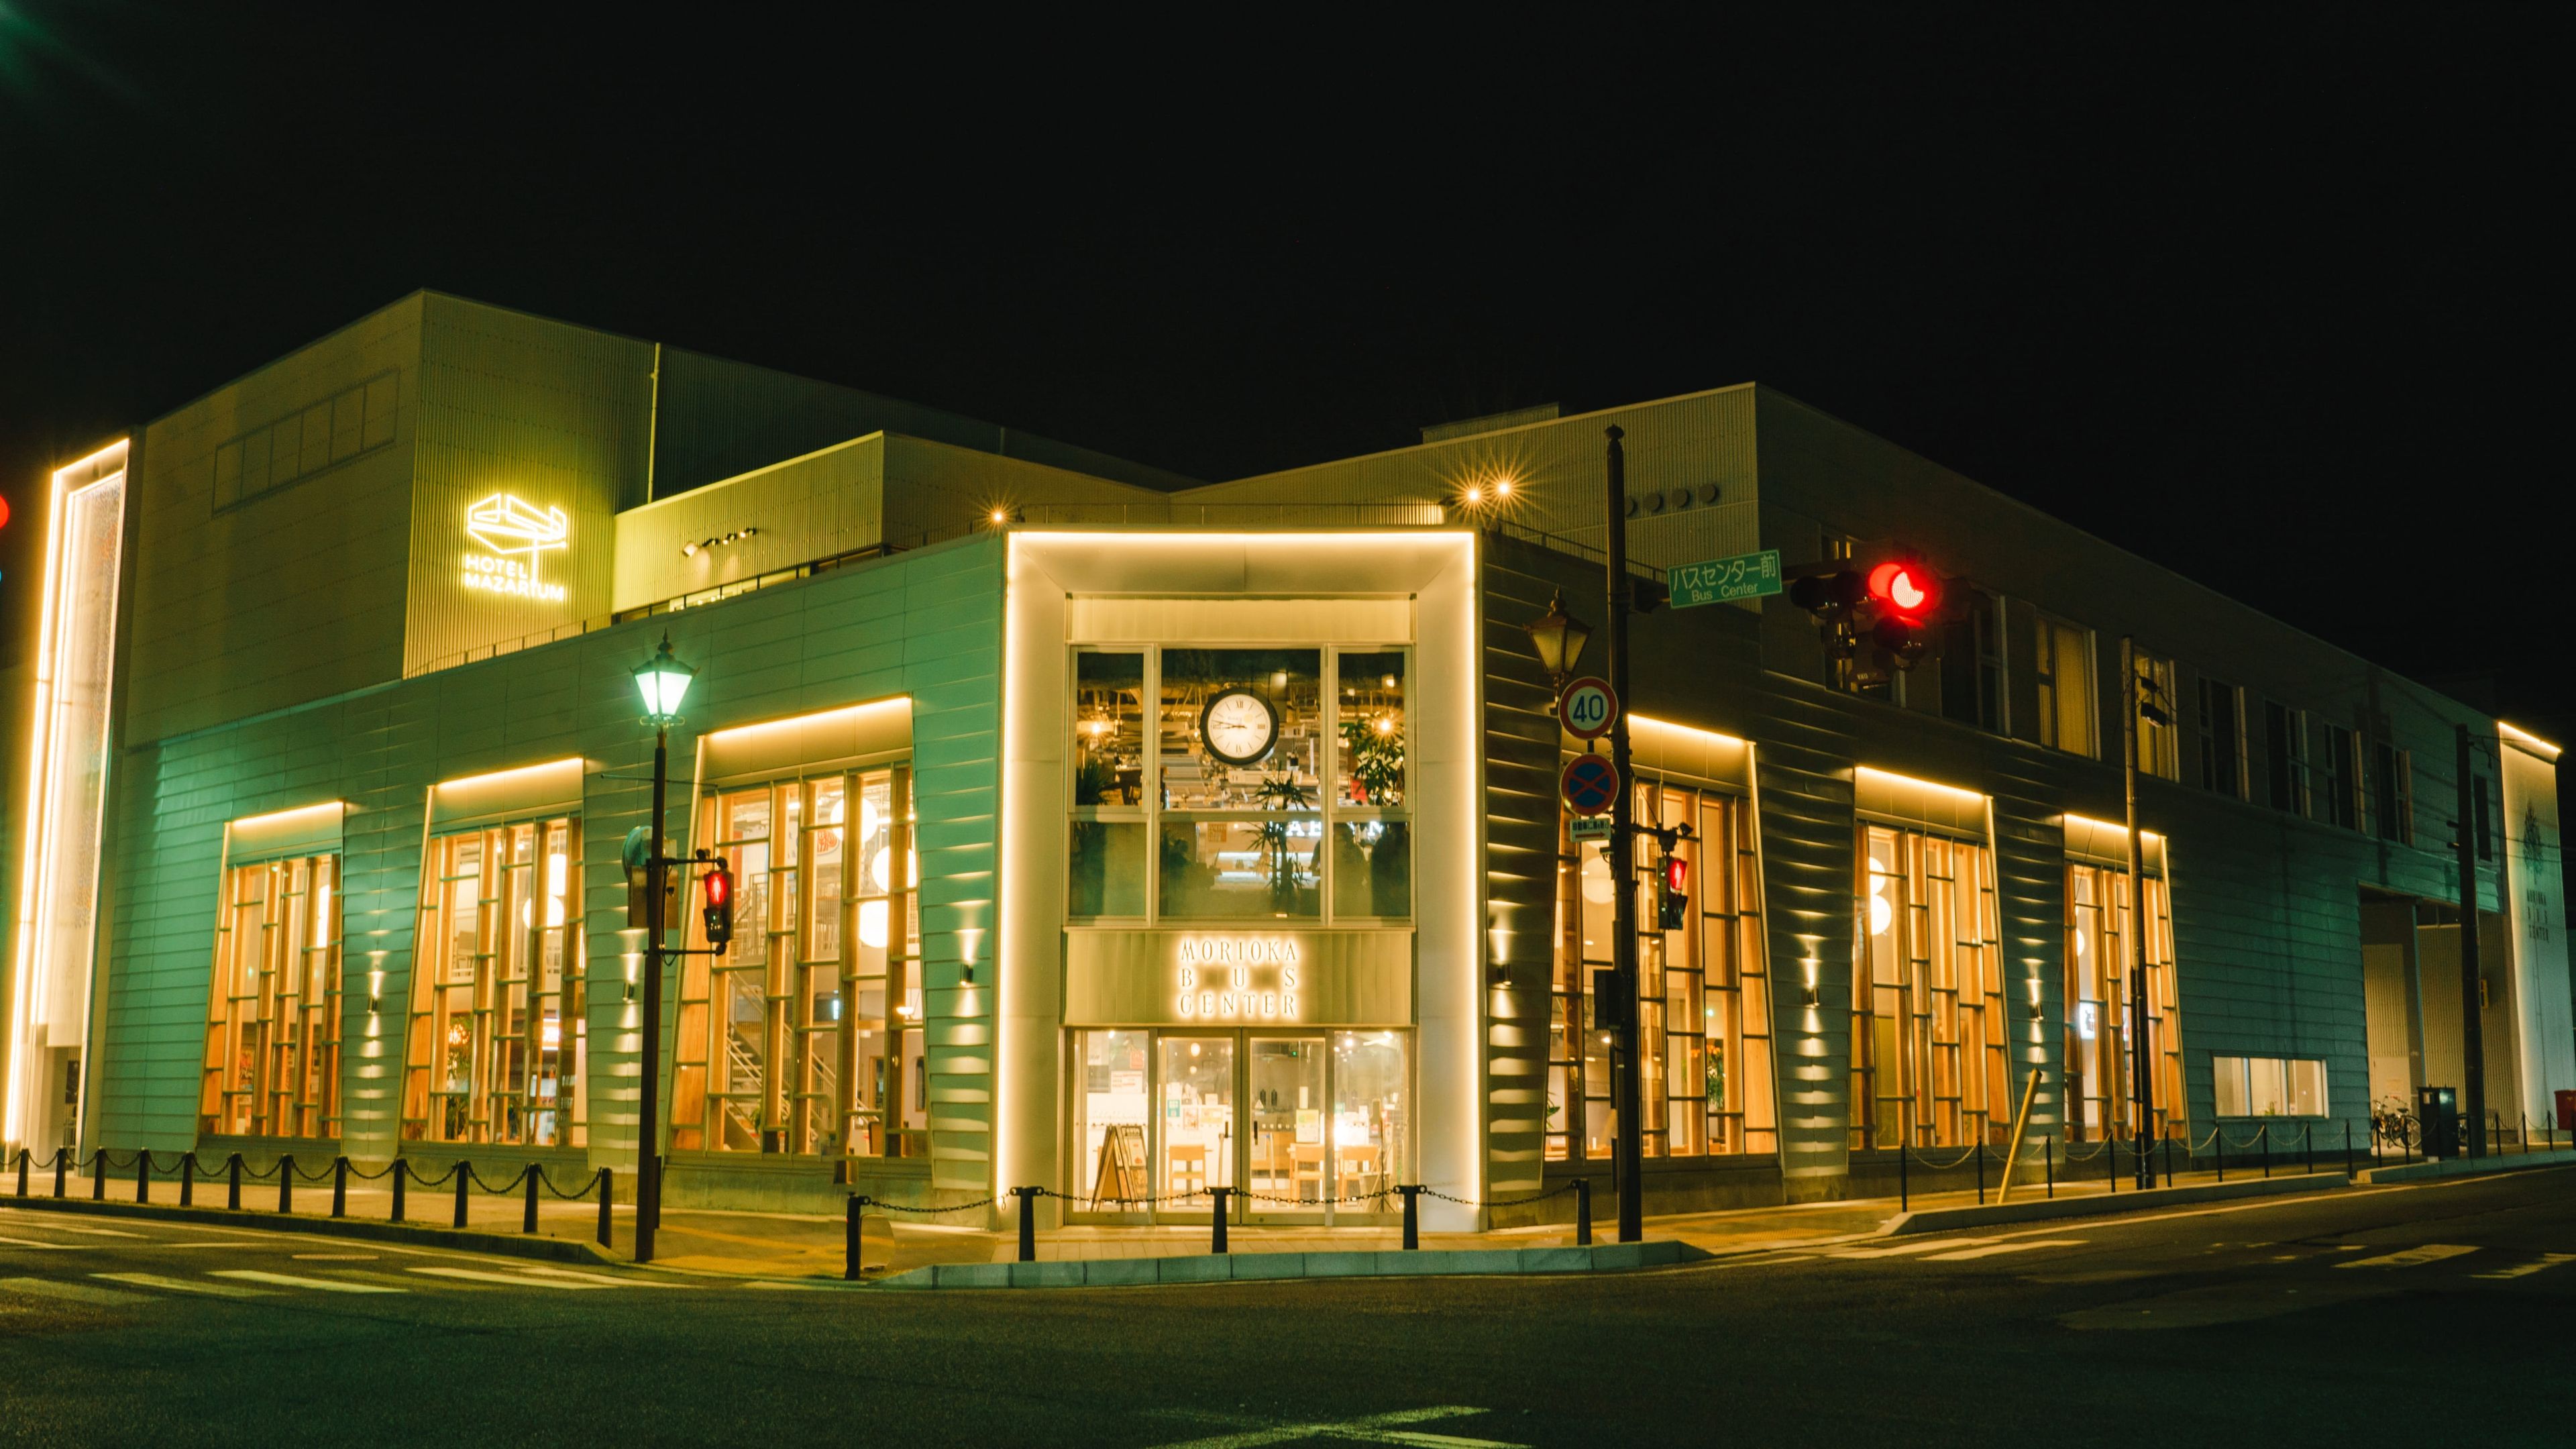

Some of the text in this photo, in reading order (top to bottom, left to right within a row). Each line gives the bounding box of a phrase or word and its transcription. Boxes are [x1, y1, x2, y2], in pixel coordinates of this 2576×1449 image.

[465, 554, 528, 579] HOTEL
[1673, 554, 1777, 591] バスセンター前
[464, 572, 565, 602] MAZARIUM
[1691, 582, 1759, 602] Bus Center
[1572, 694, 1605, 722] 40
[1181, 939, 1297, 963] MORIOKA
[1181, 967, 1295, 987] BUS
[1180, 993, 1295, 1017] CENTER
